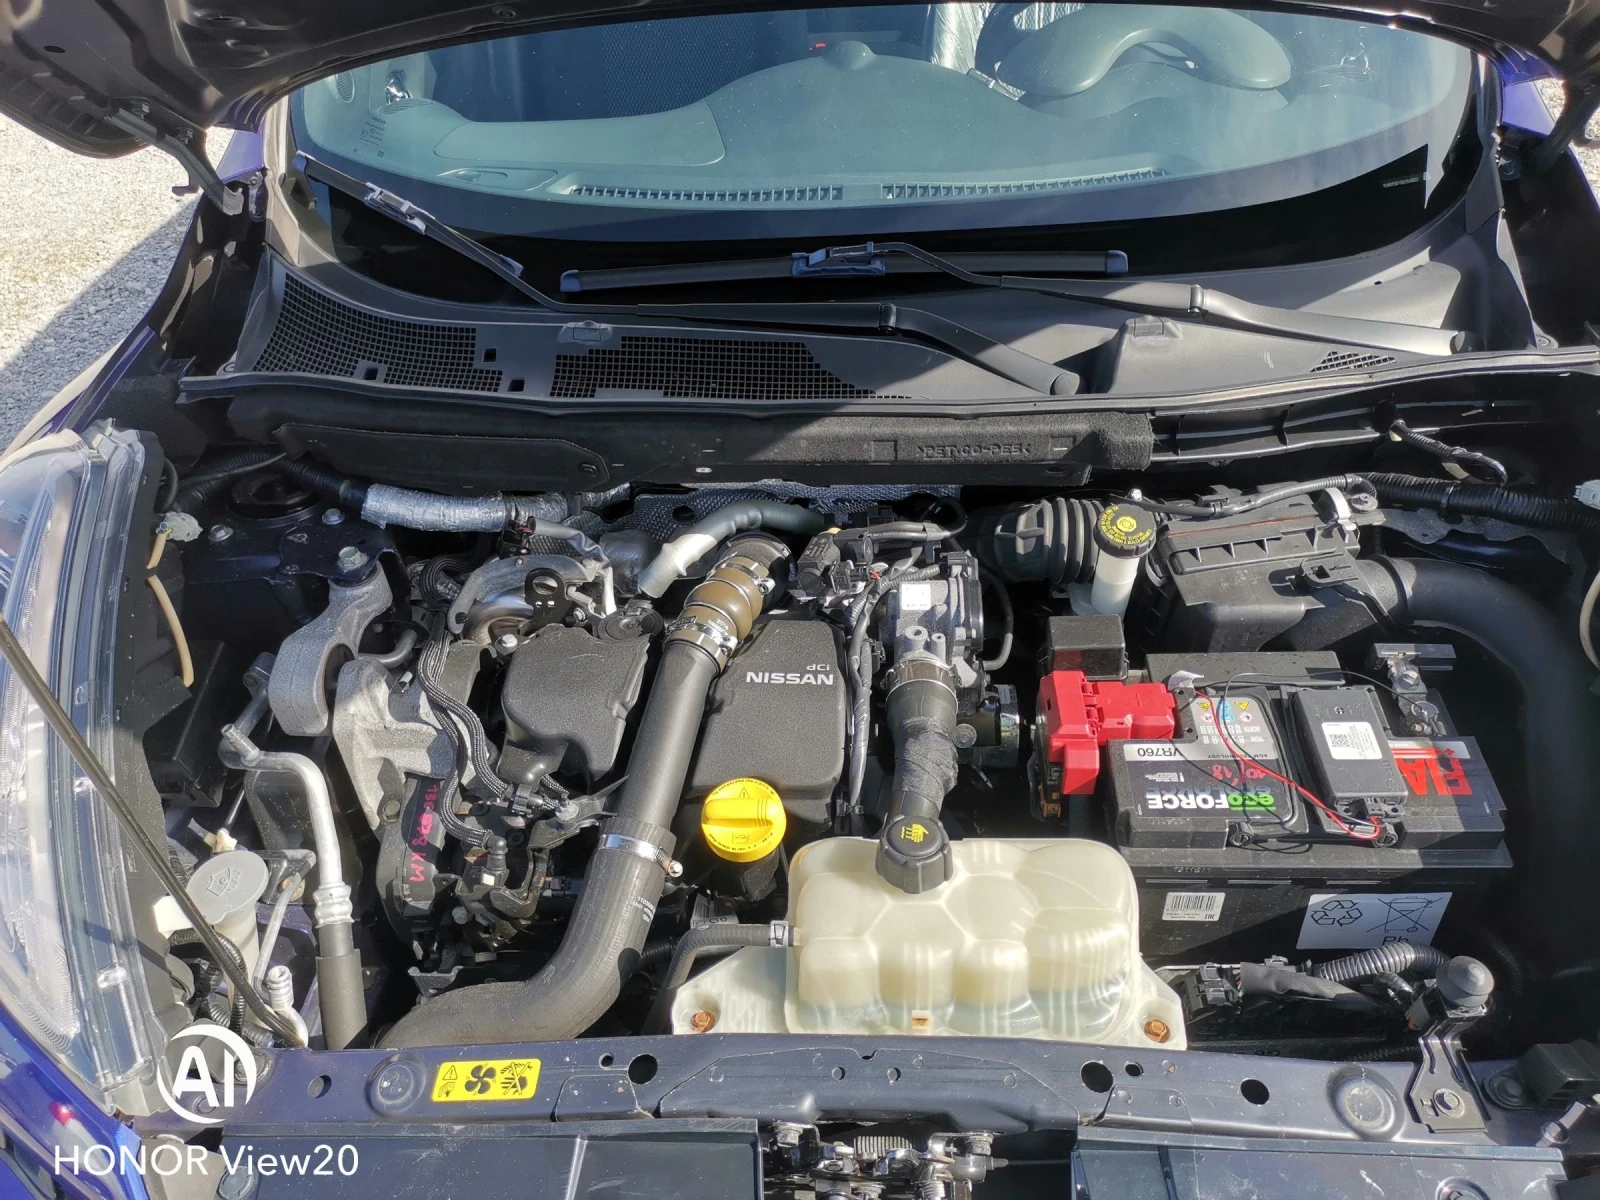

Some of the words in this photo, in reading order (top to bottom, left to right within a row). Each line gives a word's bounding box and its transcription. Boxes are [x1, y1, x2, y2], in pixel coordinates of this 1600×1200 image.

[806, 663, 830, 671] dCi
[746, 671, 834, 686] NISSAN
[1137, 747, 1183, 757] VR760
[1146, 794, 1274, 809] ecoFORCE
[410, 851, 427, 883] KM
